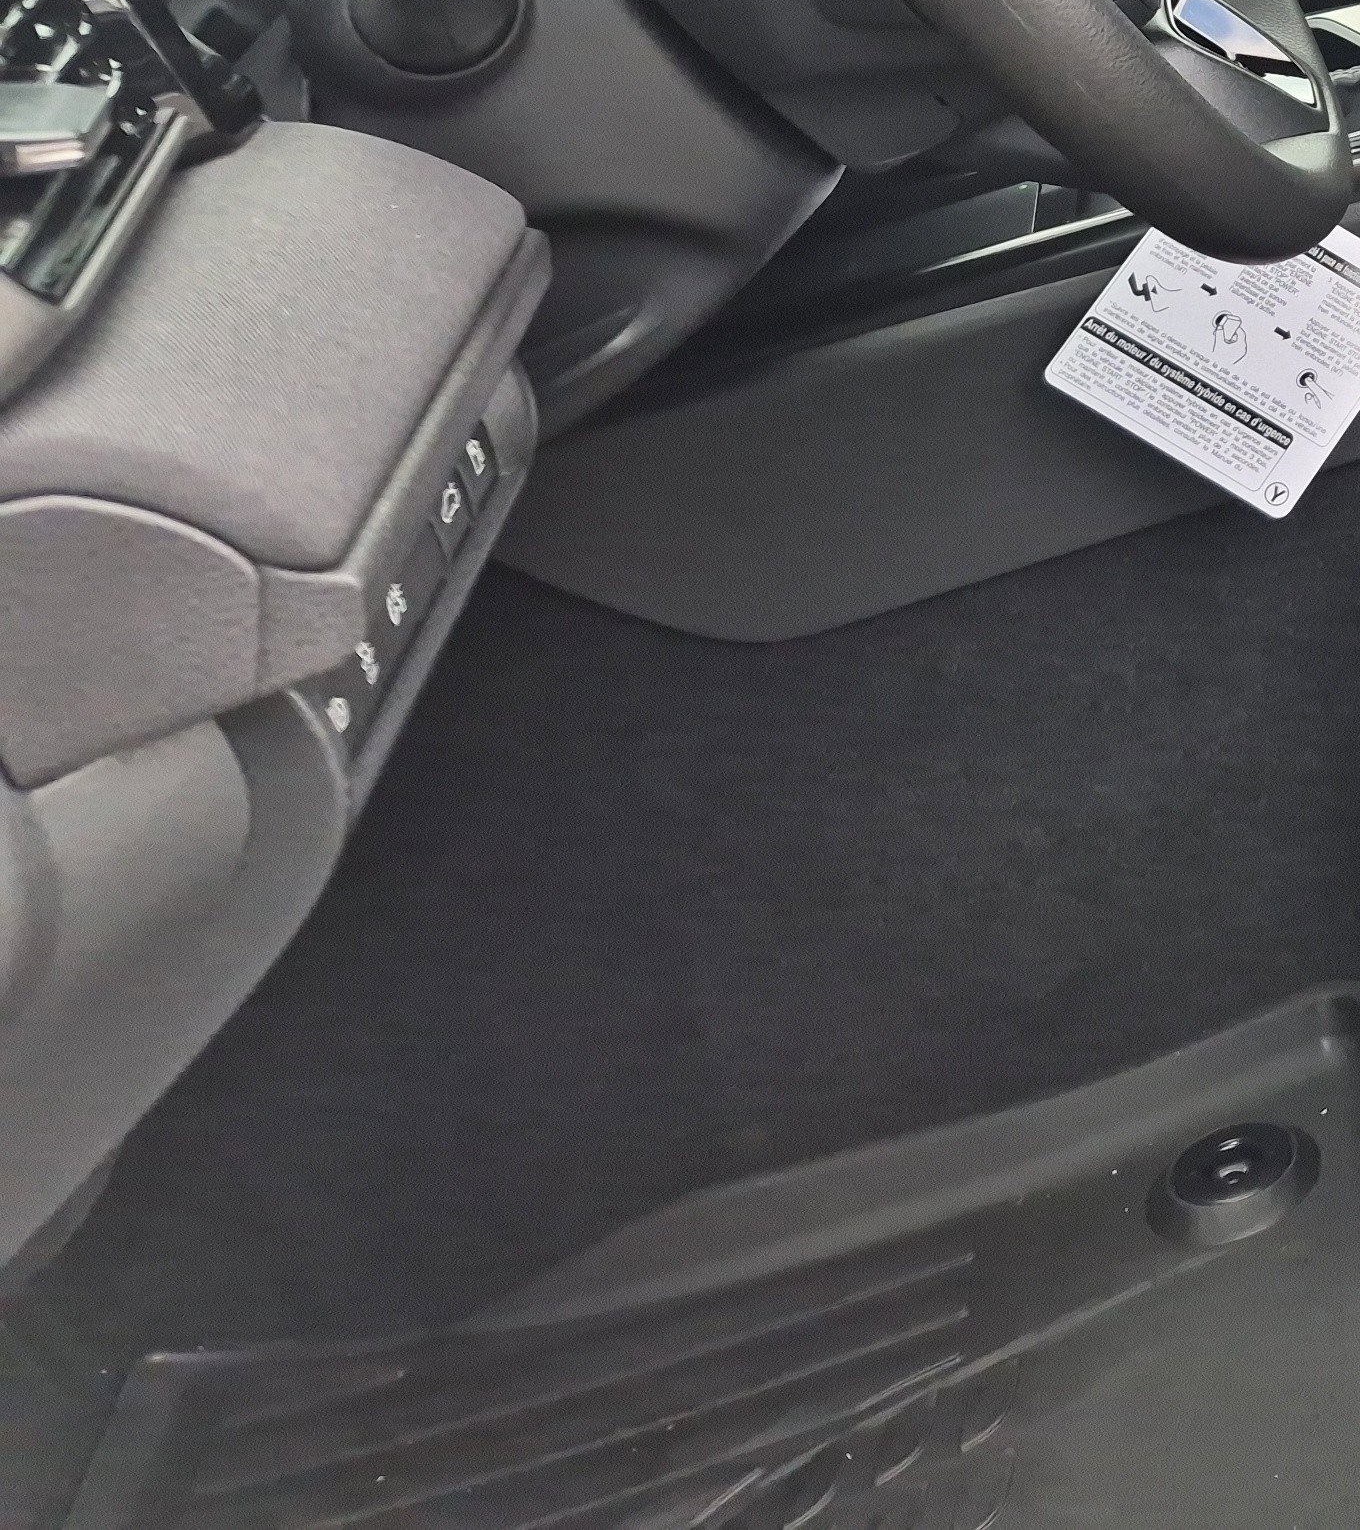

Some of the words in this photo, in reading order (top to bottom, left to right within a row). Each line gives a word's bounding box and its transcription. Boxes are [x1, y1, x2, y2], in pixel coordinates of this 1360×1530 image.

[1083, 317, 1108, 337] Arrêt
[1103, 329, 1119, 343] du
[1115, 336, 1148, 360] moteur
[1143, 352, 1153, 363] /
[1148, 355, 1164, 369] du
[1158, 362, 1197, 391] système
[1191, 381, 1227, 409] hybride
[1223, 401, 1237, 413] en
[1234, 407, 1252, 422] cas
[1247, 415, 1292, 448] d'urgence
[1267, 485, 1286, 504] Y
